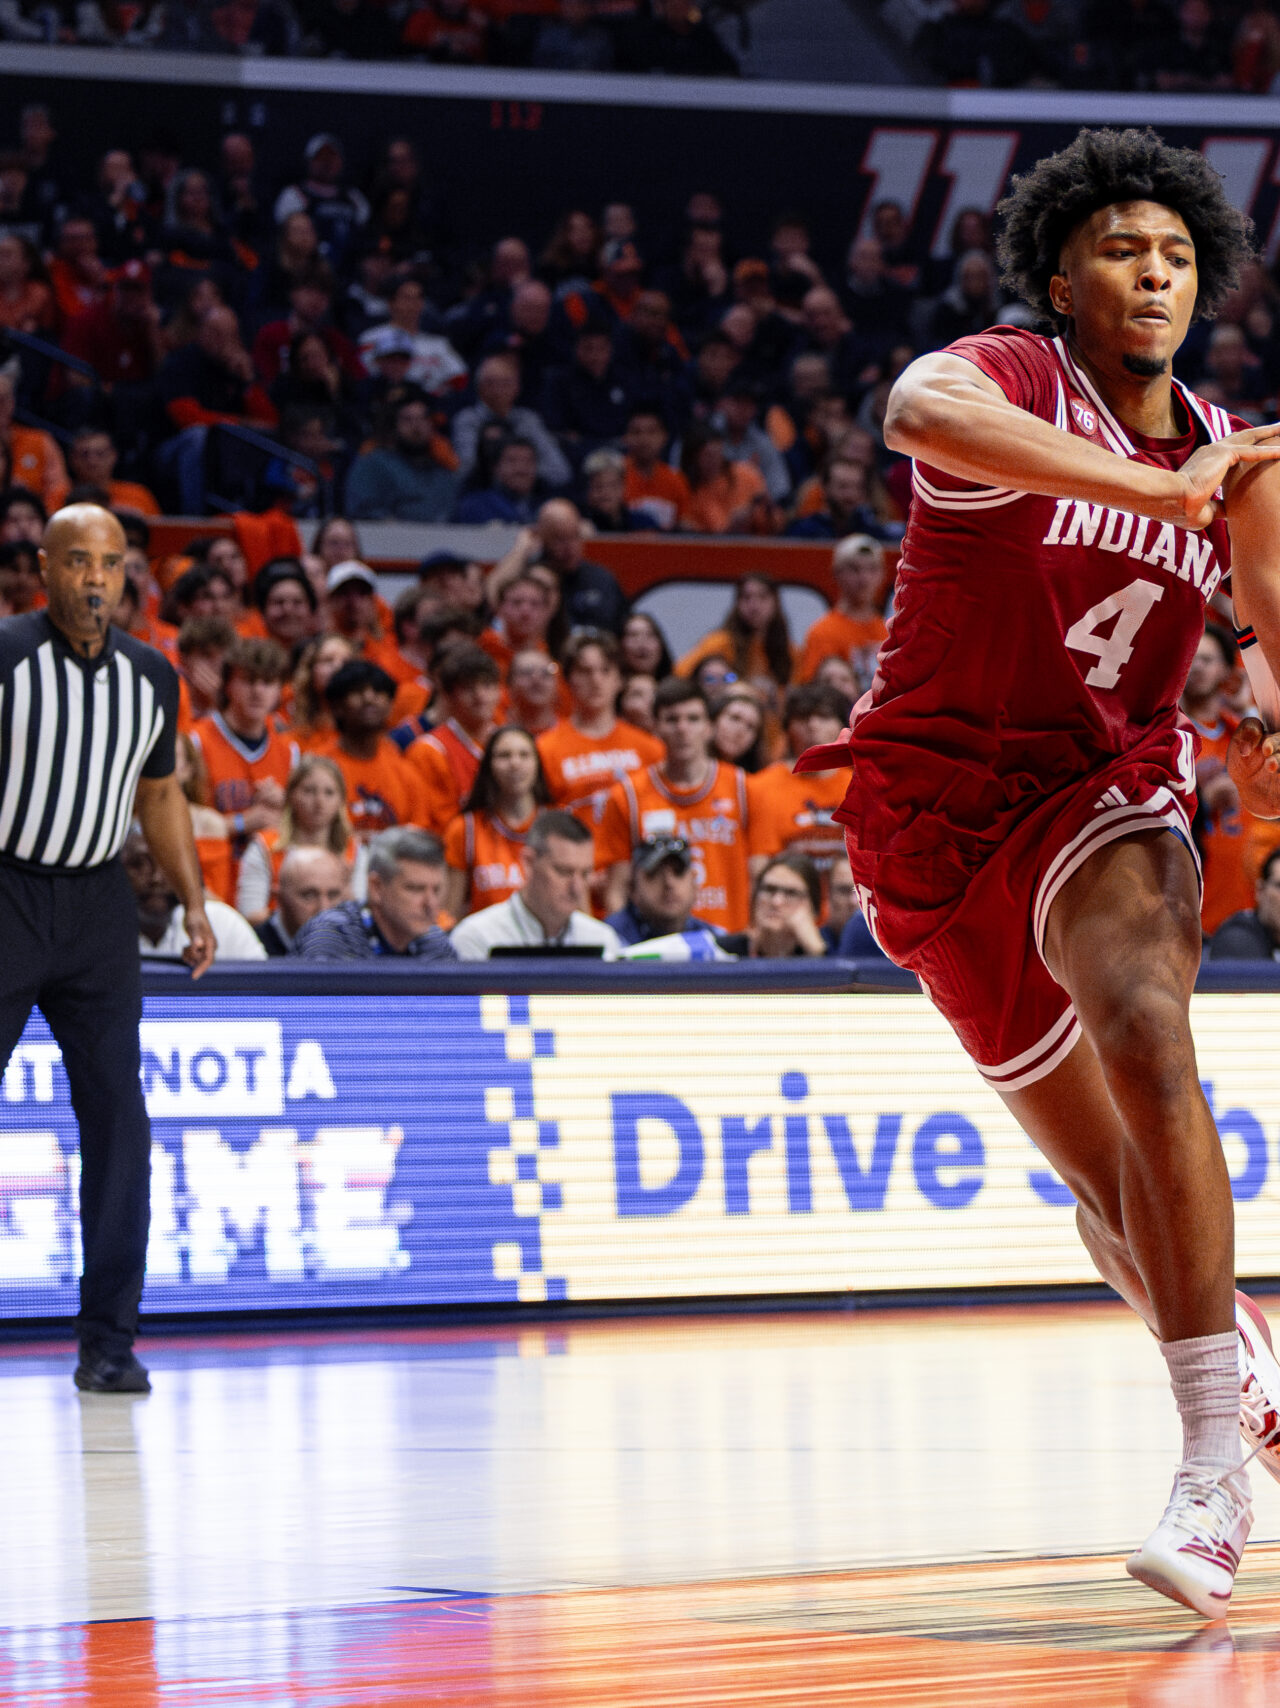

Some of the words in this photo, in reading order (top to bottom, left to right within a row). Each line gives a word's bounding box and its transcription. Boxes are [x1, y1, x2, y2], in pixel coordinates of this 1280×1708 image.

[1071, 401, 1095, 430] 76
[1042, 499, 1221, 603] INDIANA
[1064, 578, 1165, 689] 4
[143, 1046, 266, 1096] NOT
[287, 1040, 337, 1099] A
[610, 1069, 985, 1218] Drive
